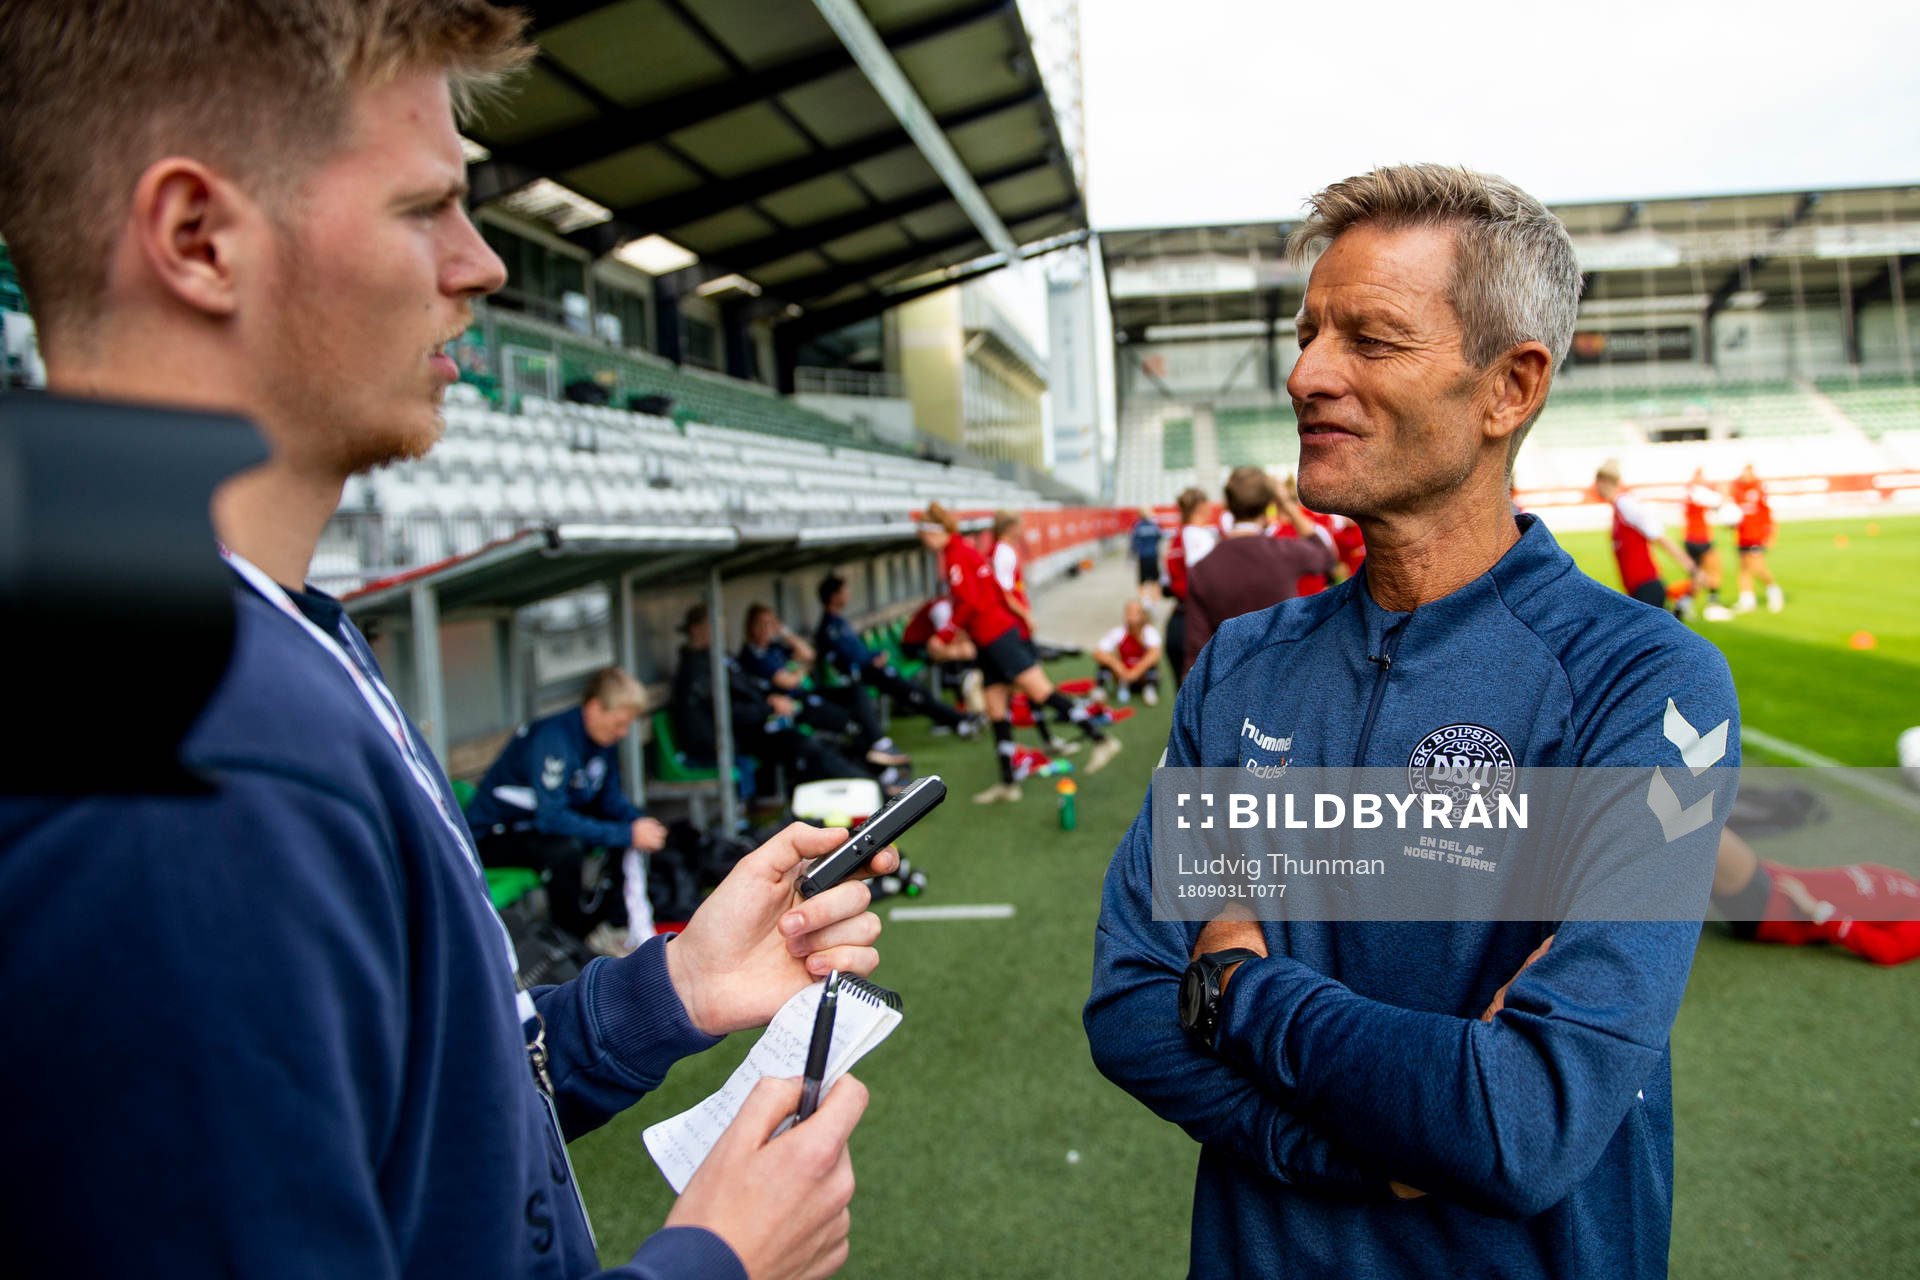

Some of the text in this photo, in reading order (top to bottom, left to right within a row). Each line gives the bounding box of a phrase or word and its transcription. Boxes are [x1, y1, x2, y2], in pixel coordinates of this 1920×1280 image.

[1240, 717, 1295, 752] hummel
[1429, 754, 1494, 788] DBU
[1403, 845, 1497, 872] NOGET STØRRE
[1419, 836, 1484, 857] EN DEL AF
